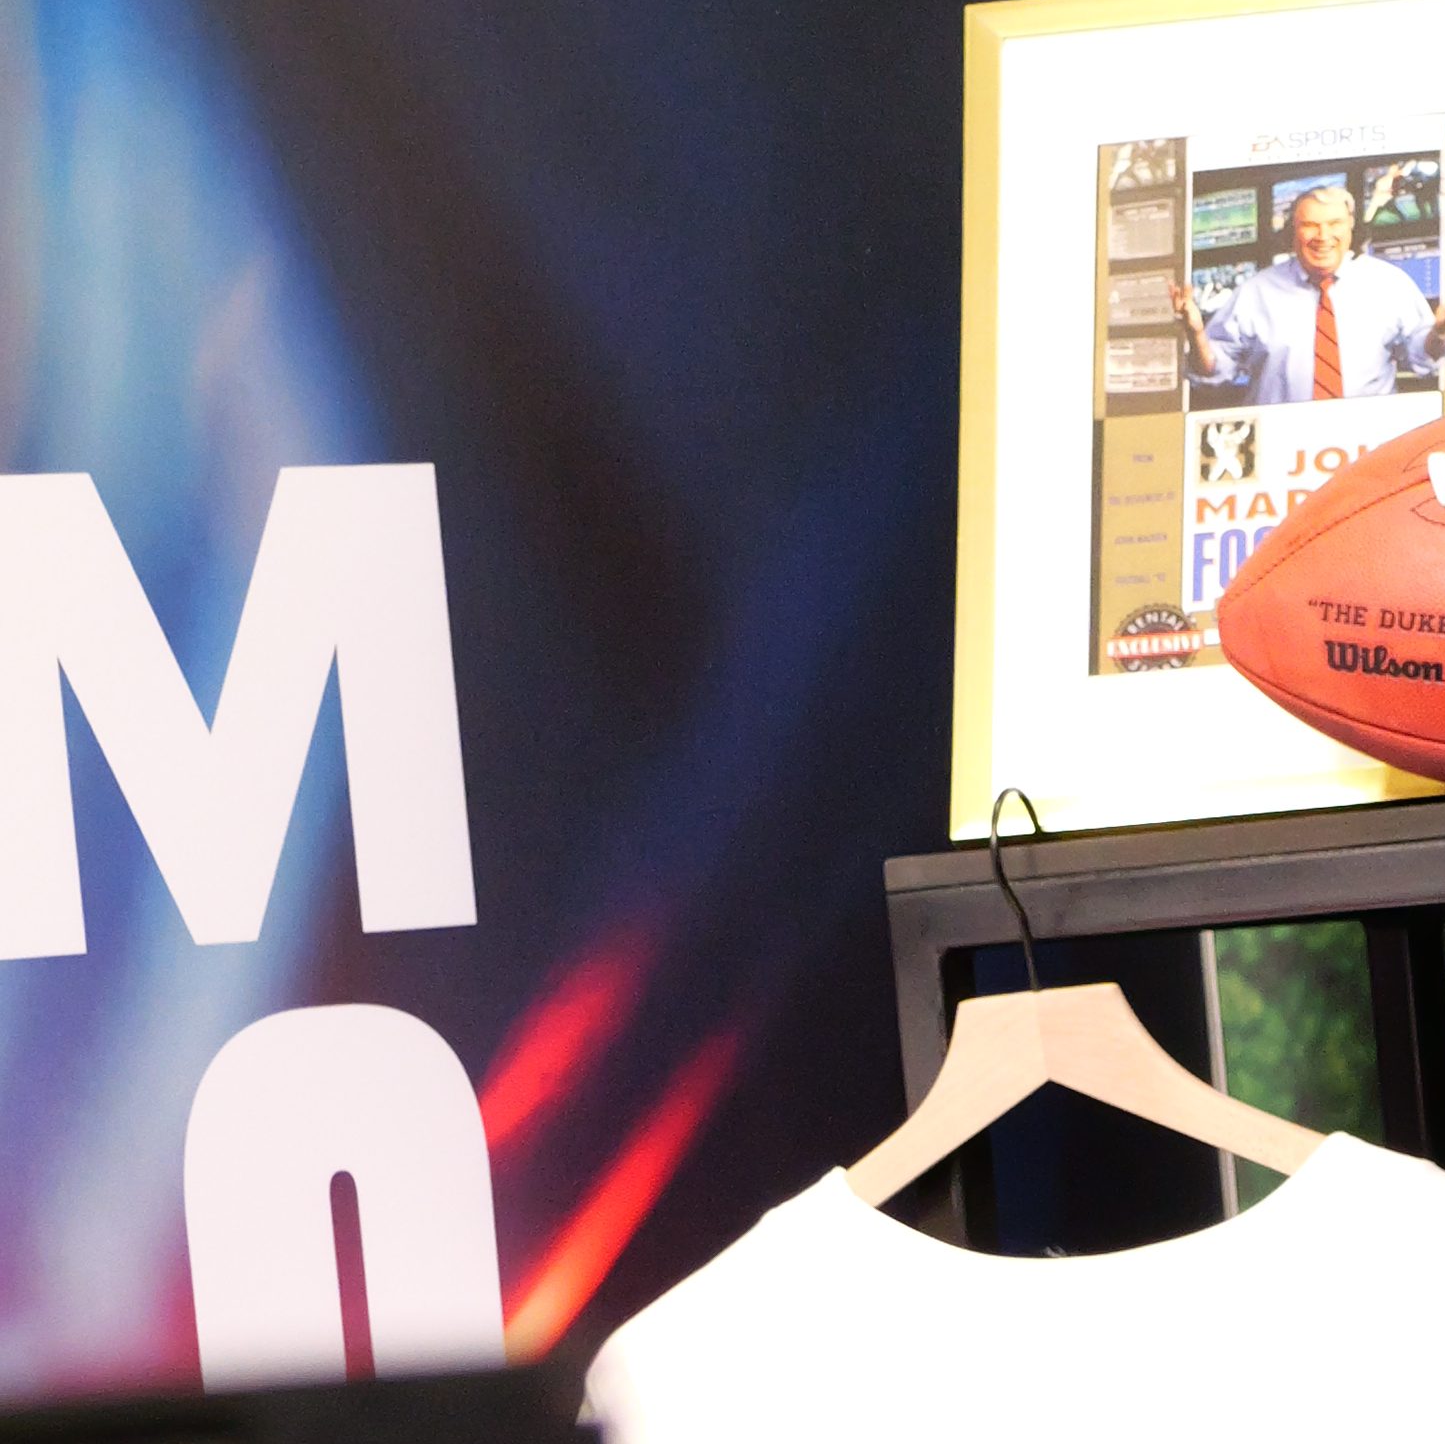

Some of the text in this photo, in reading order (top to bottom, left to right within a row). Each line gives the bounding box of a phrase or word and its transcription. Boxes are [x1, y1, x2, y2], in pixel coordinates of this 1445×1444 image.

[1287, 444, 1370, 477] JO
[1192, 525, 1276, 603] FO
[1323, 639, 1445, 683] Wilson
